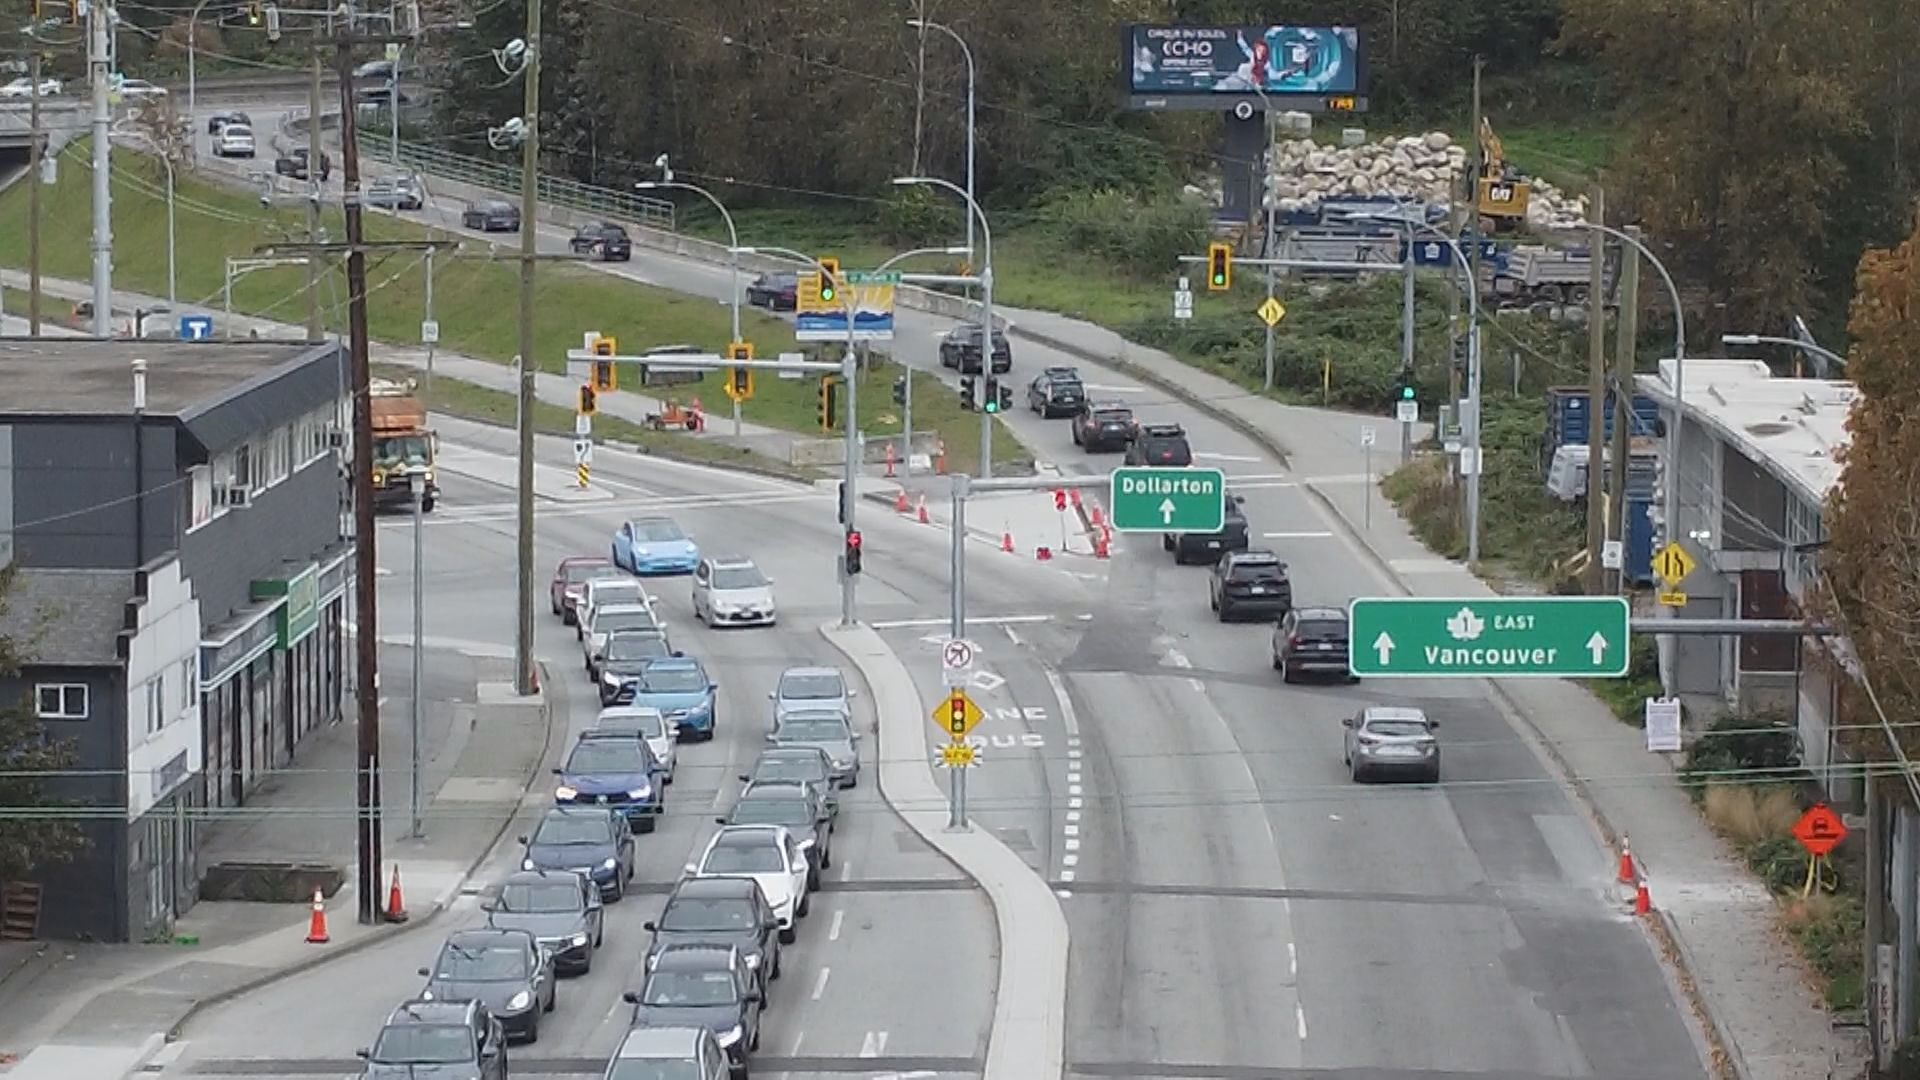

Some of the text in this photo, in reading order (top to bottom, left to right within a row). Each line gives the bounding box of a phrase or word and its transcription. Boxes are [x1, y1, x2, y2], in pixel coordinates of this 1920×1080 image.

[1122, 477, 1214, 494] Dollarton
[1493, 615, 1536, 630] EAST
[1424, 645, 1558, 666] Vancouver
